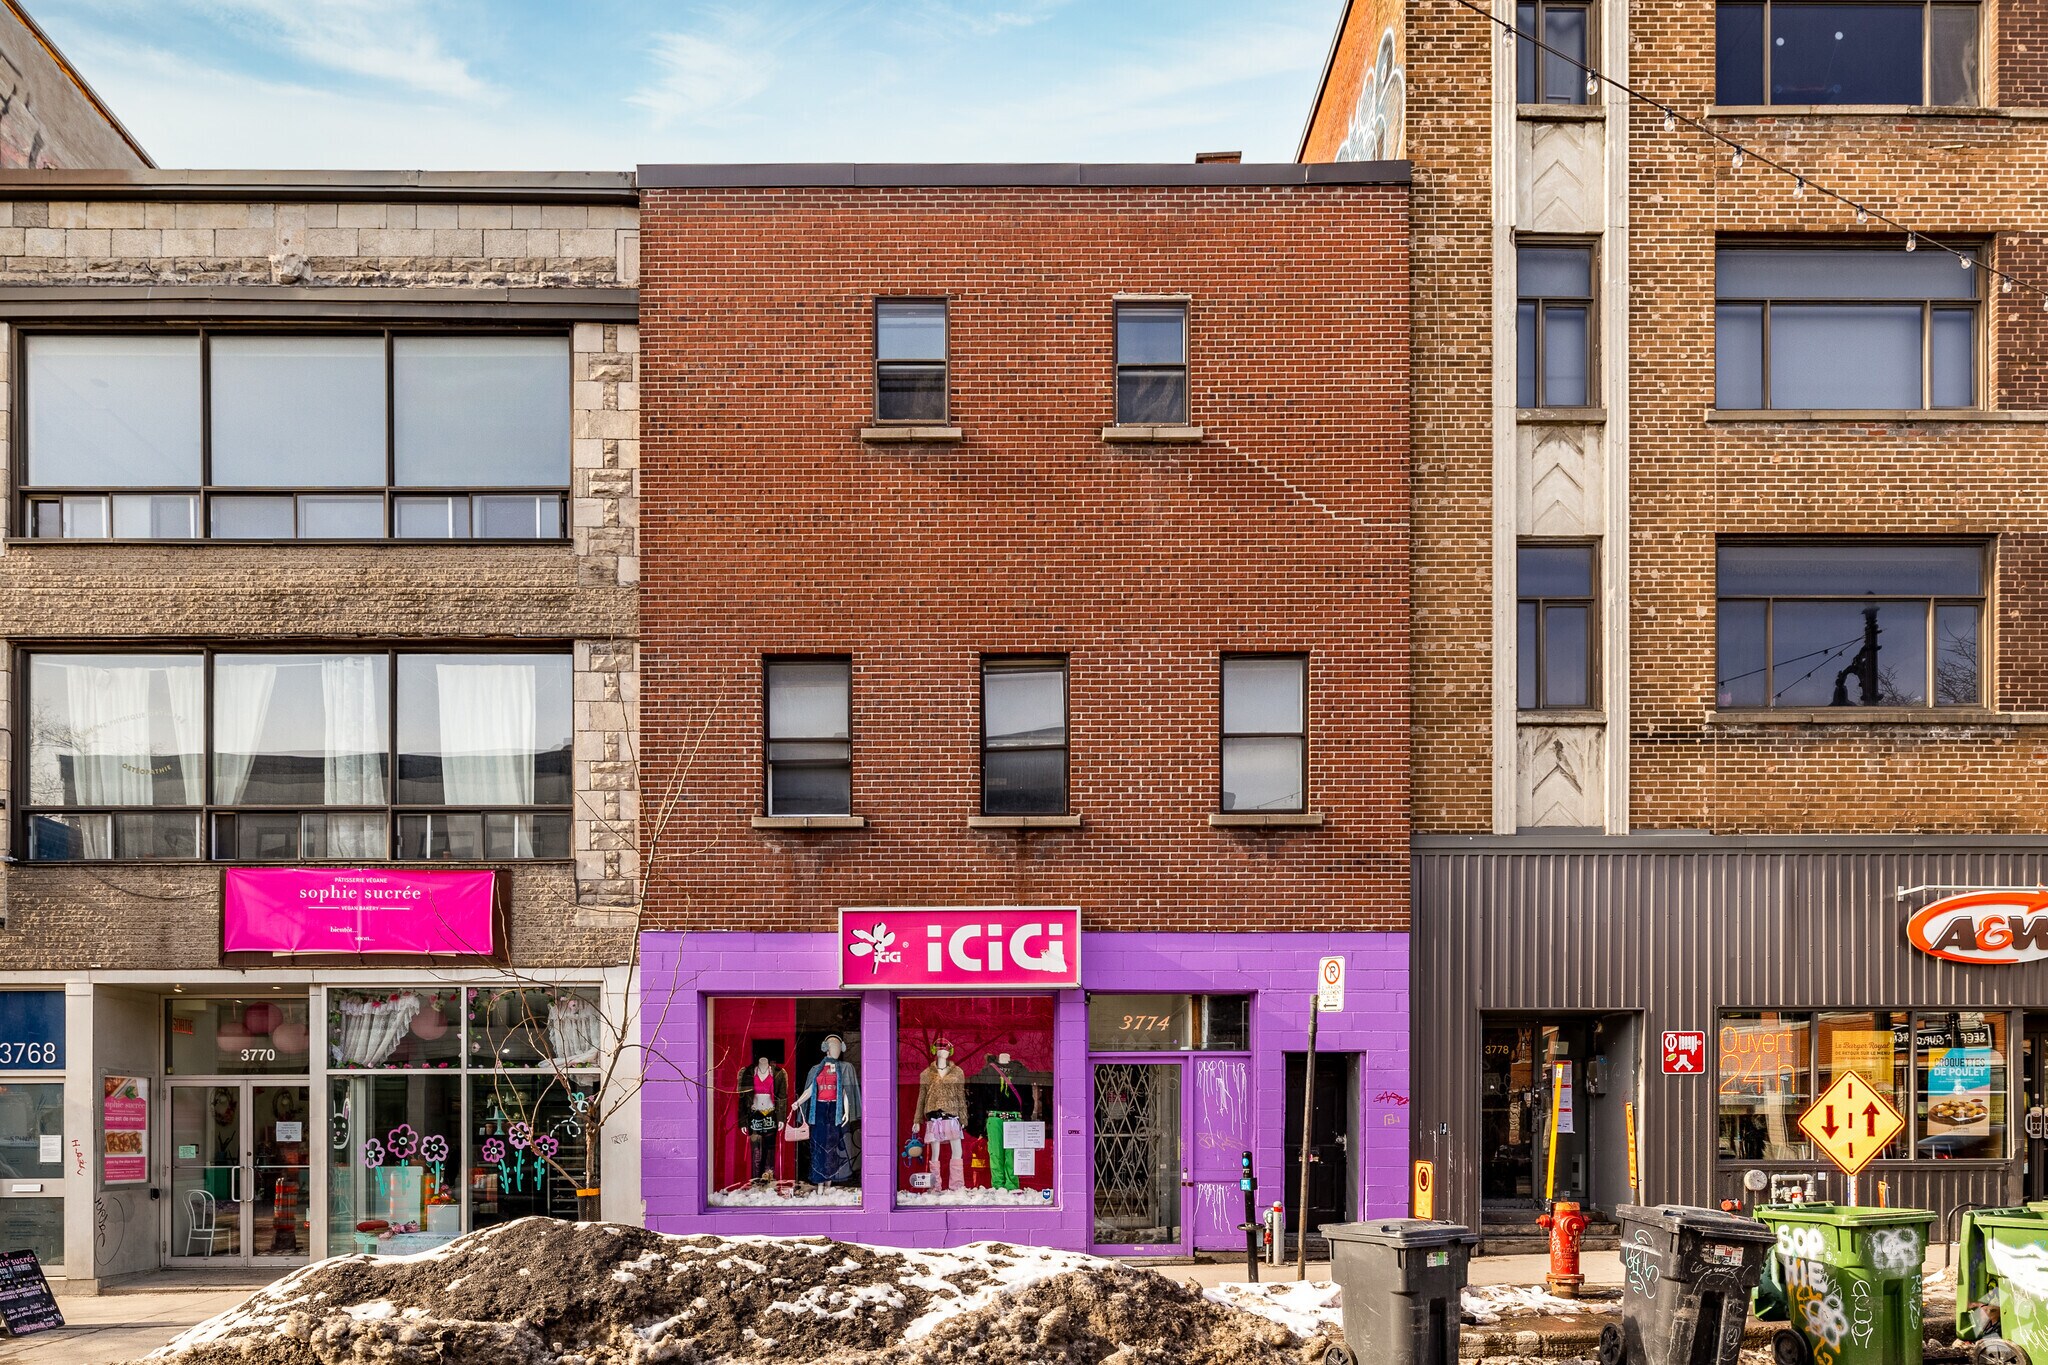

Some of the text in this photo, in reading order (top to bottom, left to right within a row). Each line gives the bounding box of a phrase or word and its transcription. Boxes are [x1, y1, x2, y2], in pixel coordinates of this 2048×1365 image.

[299, 884, 421, 903] sophie sucrée
[1929, 915, 2048, 951] A&W
[173, 1017, 193, 1033] SORTIE
[1119, 1015, 1170, 1031] 3774
[1719, 1025, 1793, 1053] Ouvert
[1843, 1042, 1867, 1051] Burger
[1868, 1041, 1891, 1051] Royal
[0, 1042, 56, 1064] 3768
[240, 1049, 276, 1061] 3770
[1485, 1045, 1509, 1055] 3778
[1934, 1057, 1985, 1067] CROQUETTES
[1719, 1054, 1795, 1094] 24 h
[1934, 1067, 1985, 1076] DE POULET
[125, 1101, 145, 1109] sucrée
